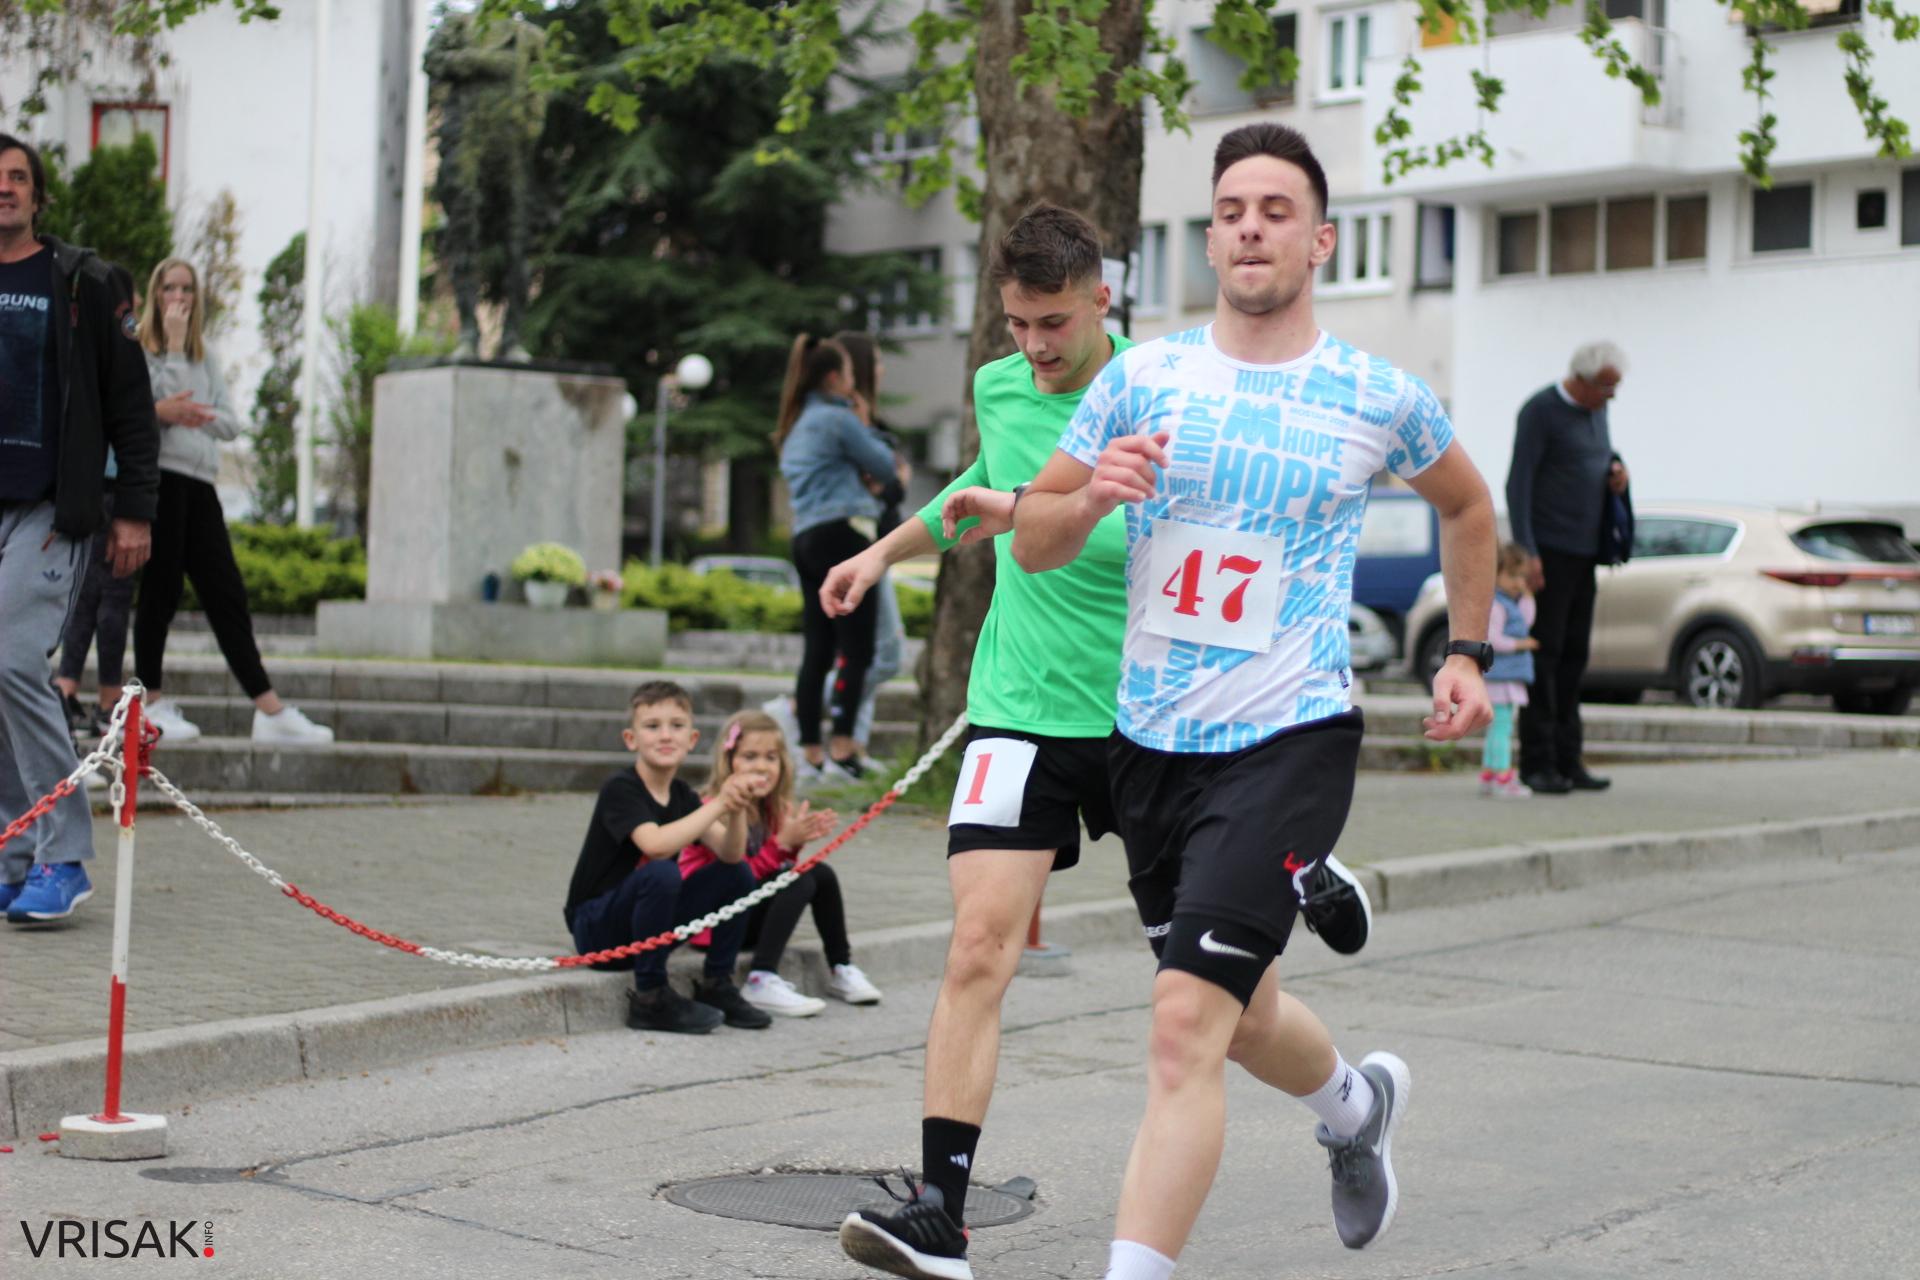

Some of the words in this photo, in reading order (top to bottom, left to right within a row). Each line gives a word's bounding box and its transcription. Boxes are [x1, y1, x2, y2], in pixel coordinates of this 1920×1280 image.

[1171, 391, 1227, 465] HOPE
[1282, 426, 1346, 467] HOPE
[1168, 476, 1208, 500] HOPE
[1209, 445, 1342, 522] HOPE
[1161, 548, 1263, 623] 47
[962, 753, 993, 805] 1
